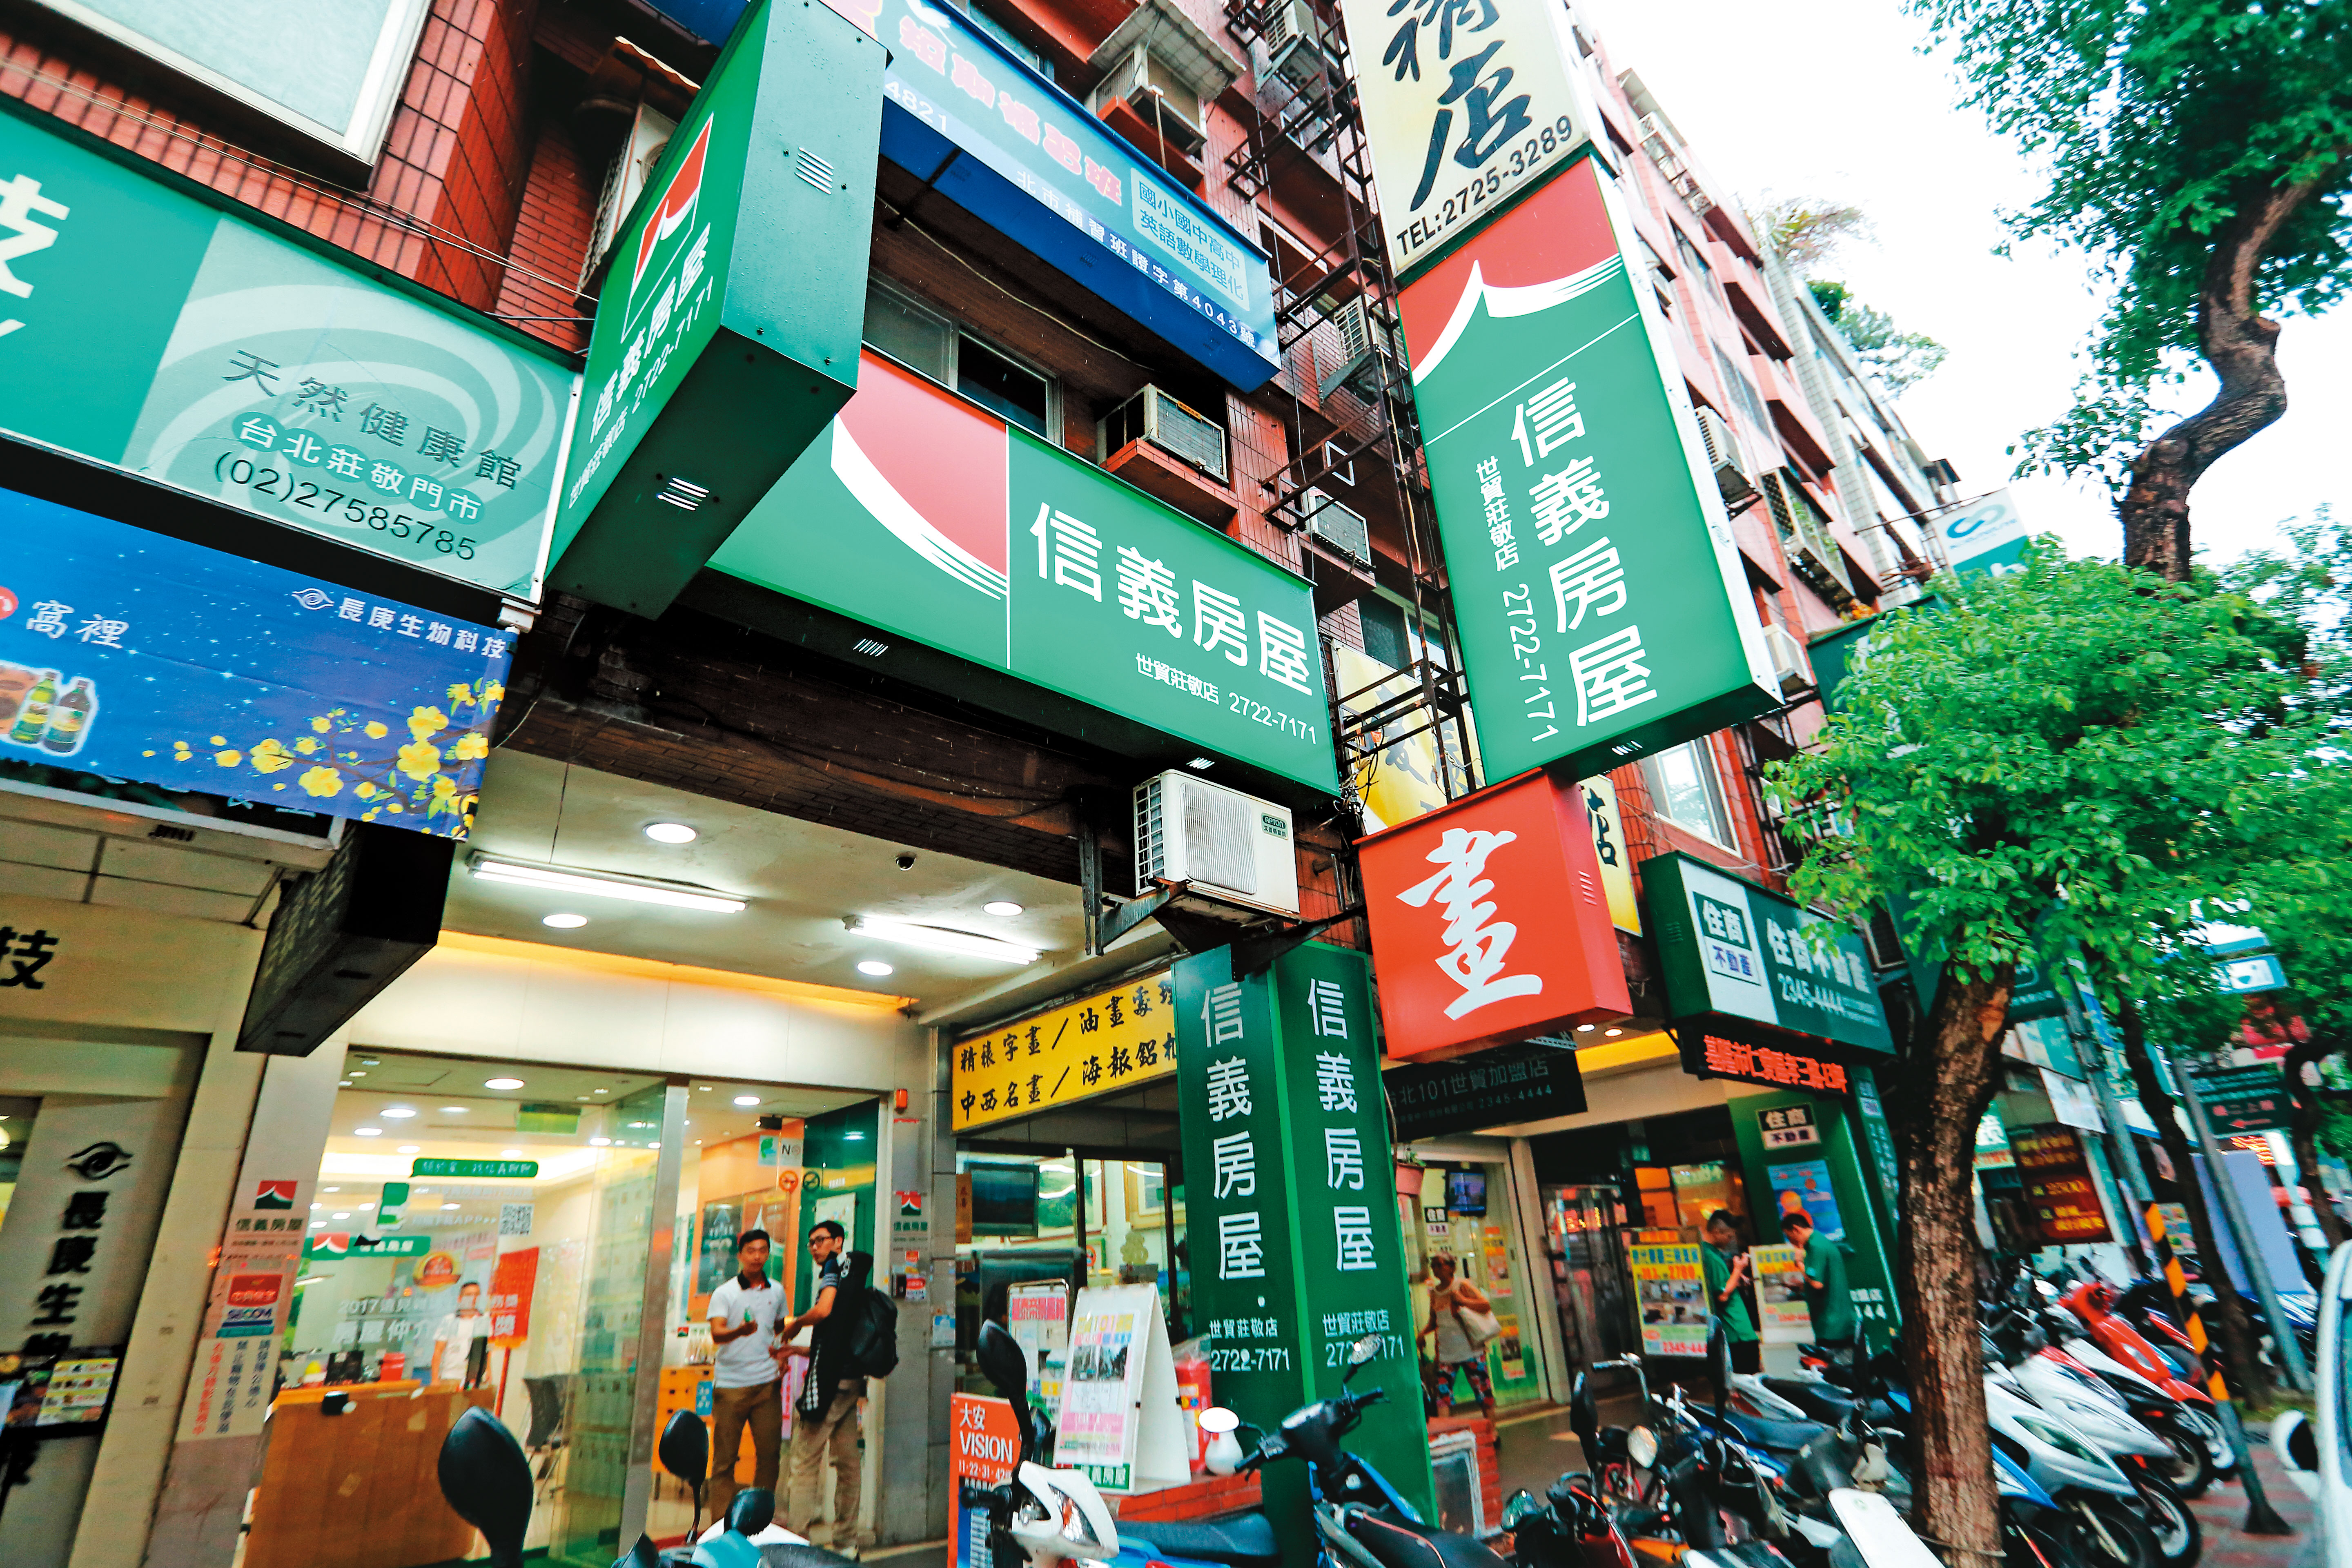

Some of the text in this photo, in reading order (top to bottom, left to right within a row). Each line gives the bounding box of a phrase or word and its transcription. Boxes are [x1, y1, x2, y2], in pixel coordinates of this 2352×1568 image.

[884, 79, 949, 134] 4821
[1138, 180, 1241, 272] 國小國中高中
[1395, 115, 1572, 256] TEL:2725-3289
[1016, 169, 1257, 349] 北市補習班證字第4043號
[1140, 209, 1245, 301] 英語數學理化
[590, 222, 710, 443] 信義房屋
[632, 276, 713, 414] 2722-7171
[222, 349, 522, 491] 天然健康館
[214, 452, 476, 561] (02)27585785
[239, 417, 481, 520] 台北莊敬門市
[1510, 376, 1658, 727] 信義房屋
[26, 599, 130, 649] 窩裡
[338, 596, 507, 660] 長庚生物科技
[1029, 501, 1313, 697] 信義房屋
[1475, 455, 1559, 743] 世貿莊敬店 2722-7171
[1135, 652, 1317, 745] 世貿莊敬店 2722-7171
[1702, 899, 1746, 945] 住商
[1200, 982, 1265, 1281] 信義房屋
[1307, 977, 1377, 1272] 信義房屋
[1209, 1317, 1278, 1339] 世貿莊敬店
[1211, 1347, 1290, 1372] 2722-7171
[1322, 1309, 1390, 1338] 世貿莊敬店
[1325, 1335, 1405, 1368] 272171
[959, 1401, 986, 1431] 大安
[959, 1430, 1013, 1465] VISION
